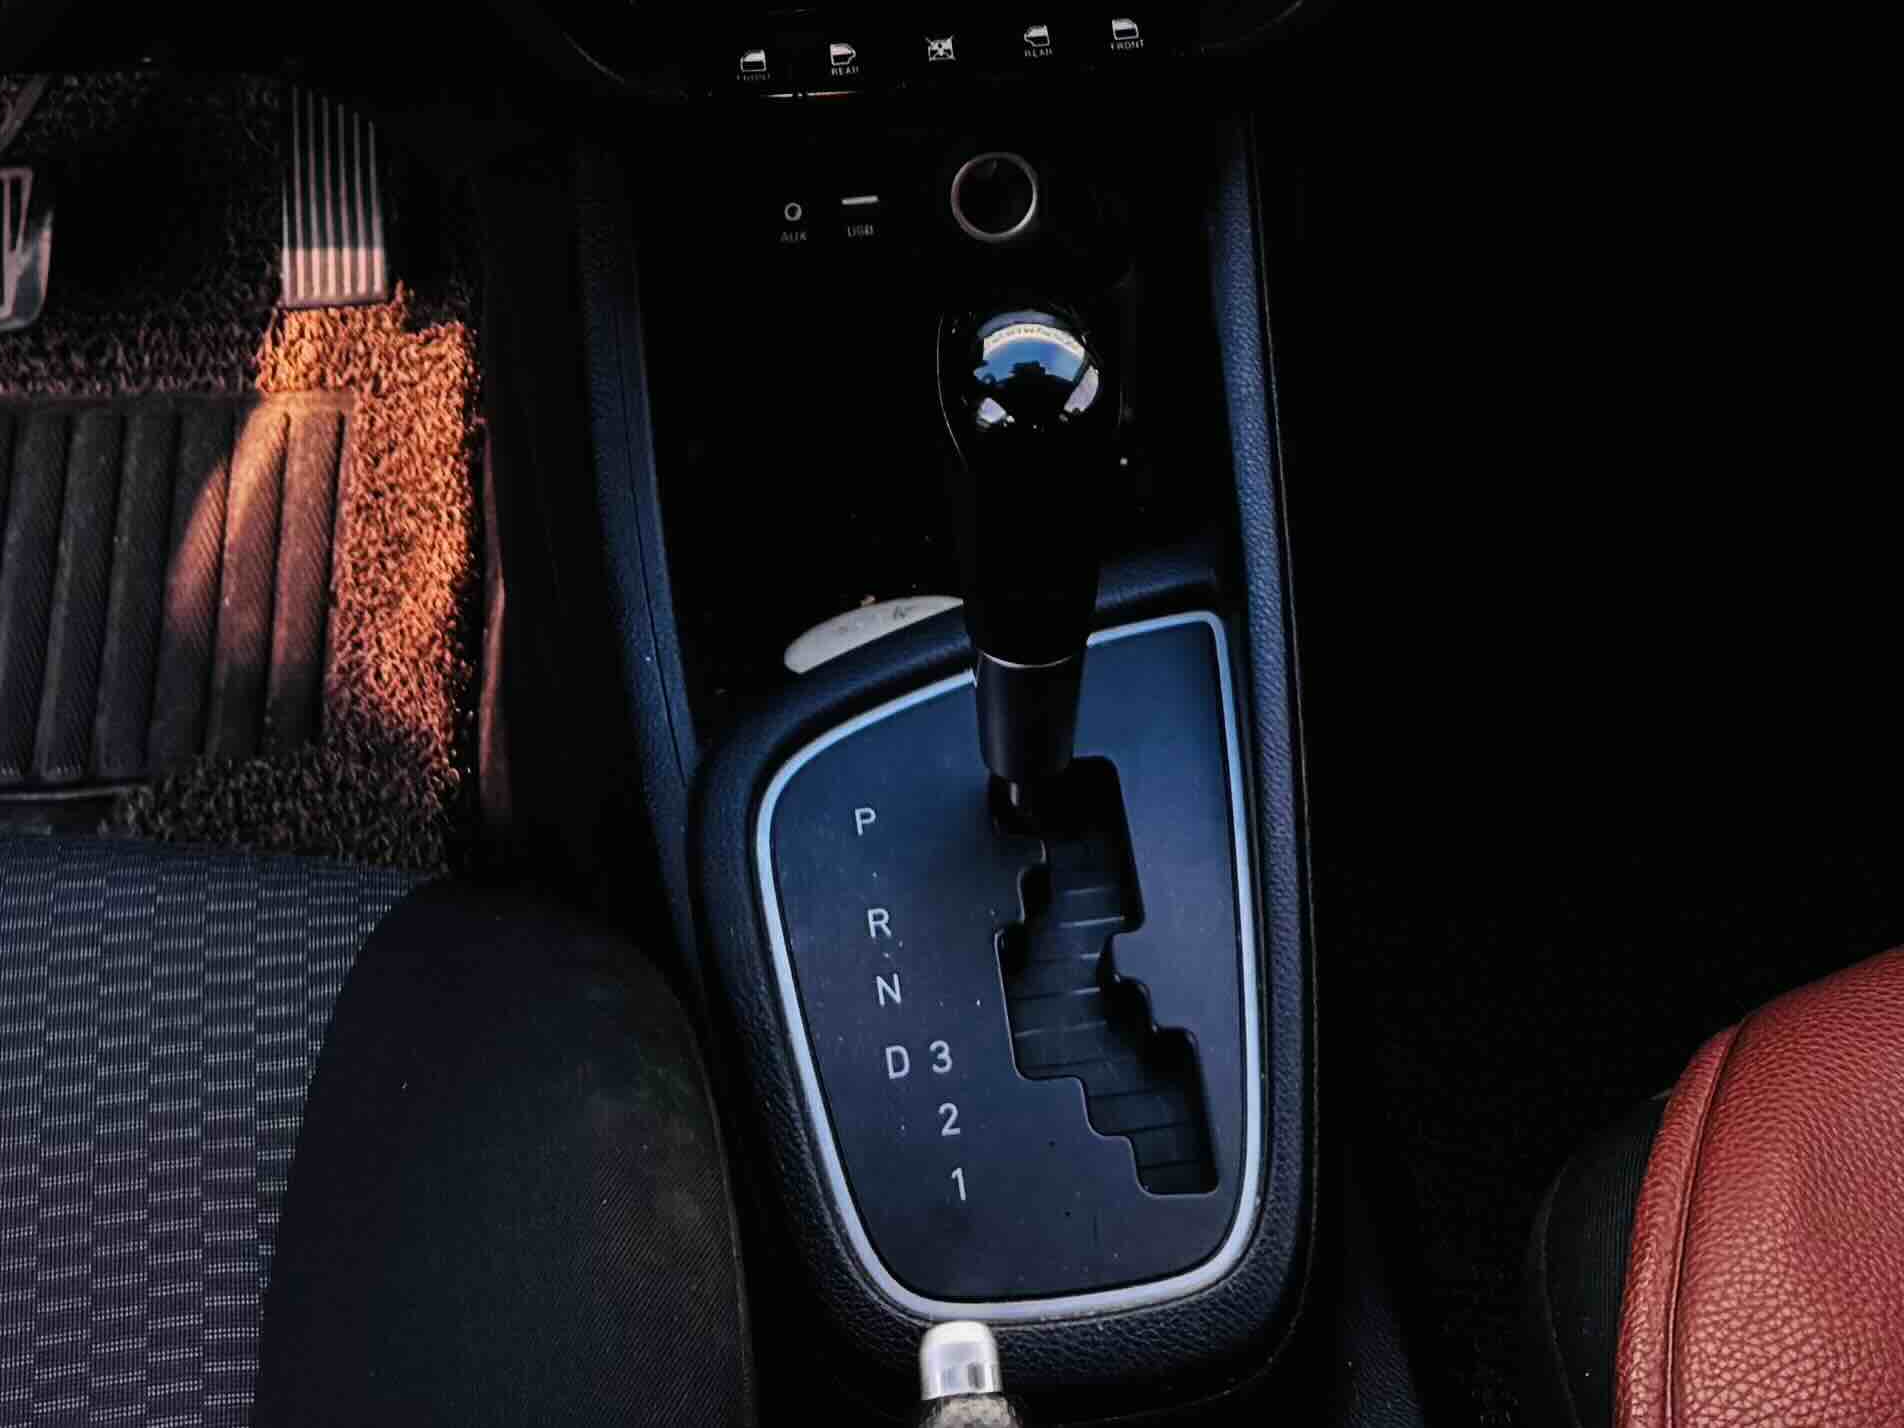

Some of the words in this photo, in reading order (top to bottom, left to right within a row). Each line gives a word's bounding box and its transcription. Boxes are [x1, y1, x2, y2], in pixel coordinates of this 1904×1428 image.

[854, 807, 877, 836] P
[867, 907, 892, 939] R
[876, 973, 902, 1006] N
[885, 1045, 911, 1080] D
[930, 1039, 953, 1074] 3
[939, 1102, 961, 1137] 2
[951, 1167, 967, 1201] 1
